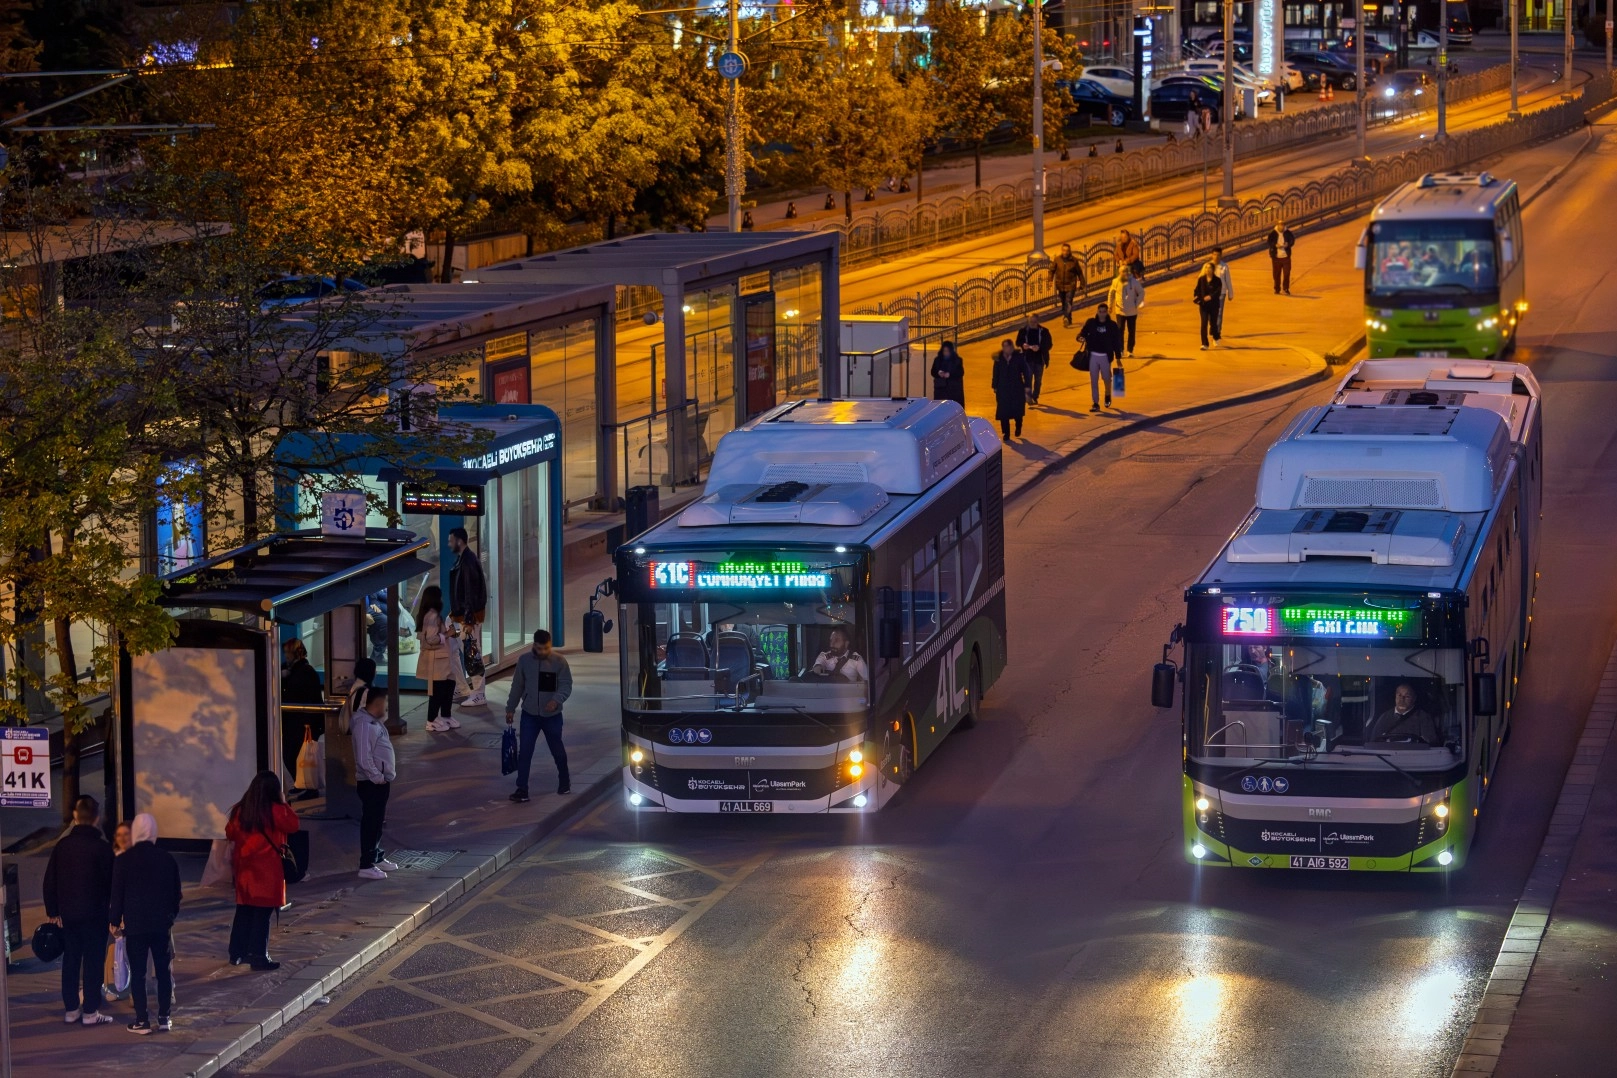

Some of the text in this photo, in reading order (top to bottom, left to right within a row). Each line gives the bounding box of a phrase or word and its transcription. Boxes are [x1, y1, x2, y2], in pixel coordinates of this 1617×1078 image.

[1227, 607, 1268, 632] 750
[5, 771, 46, 789] 41 K
[721, 803, 771, 812] 41 ALL 669
[1292, 857, 1347, 869] 41 AIG 592
